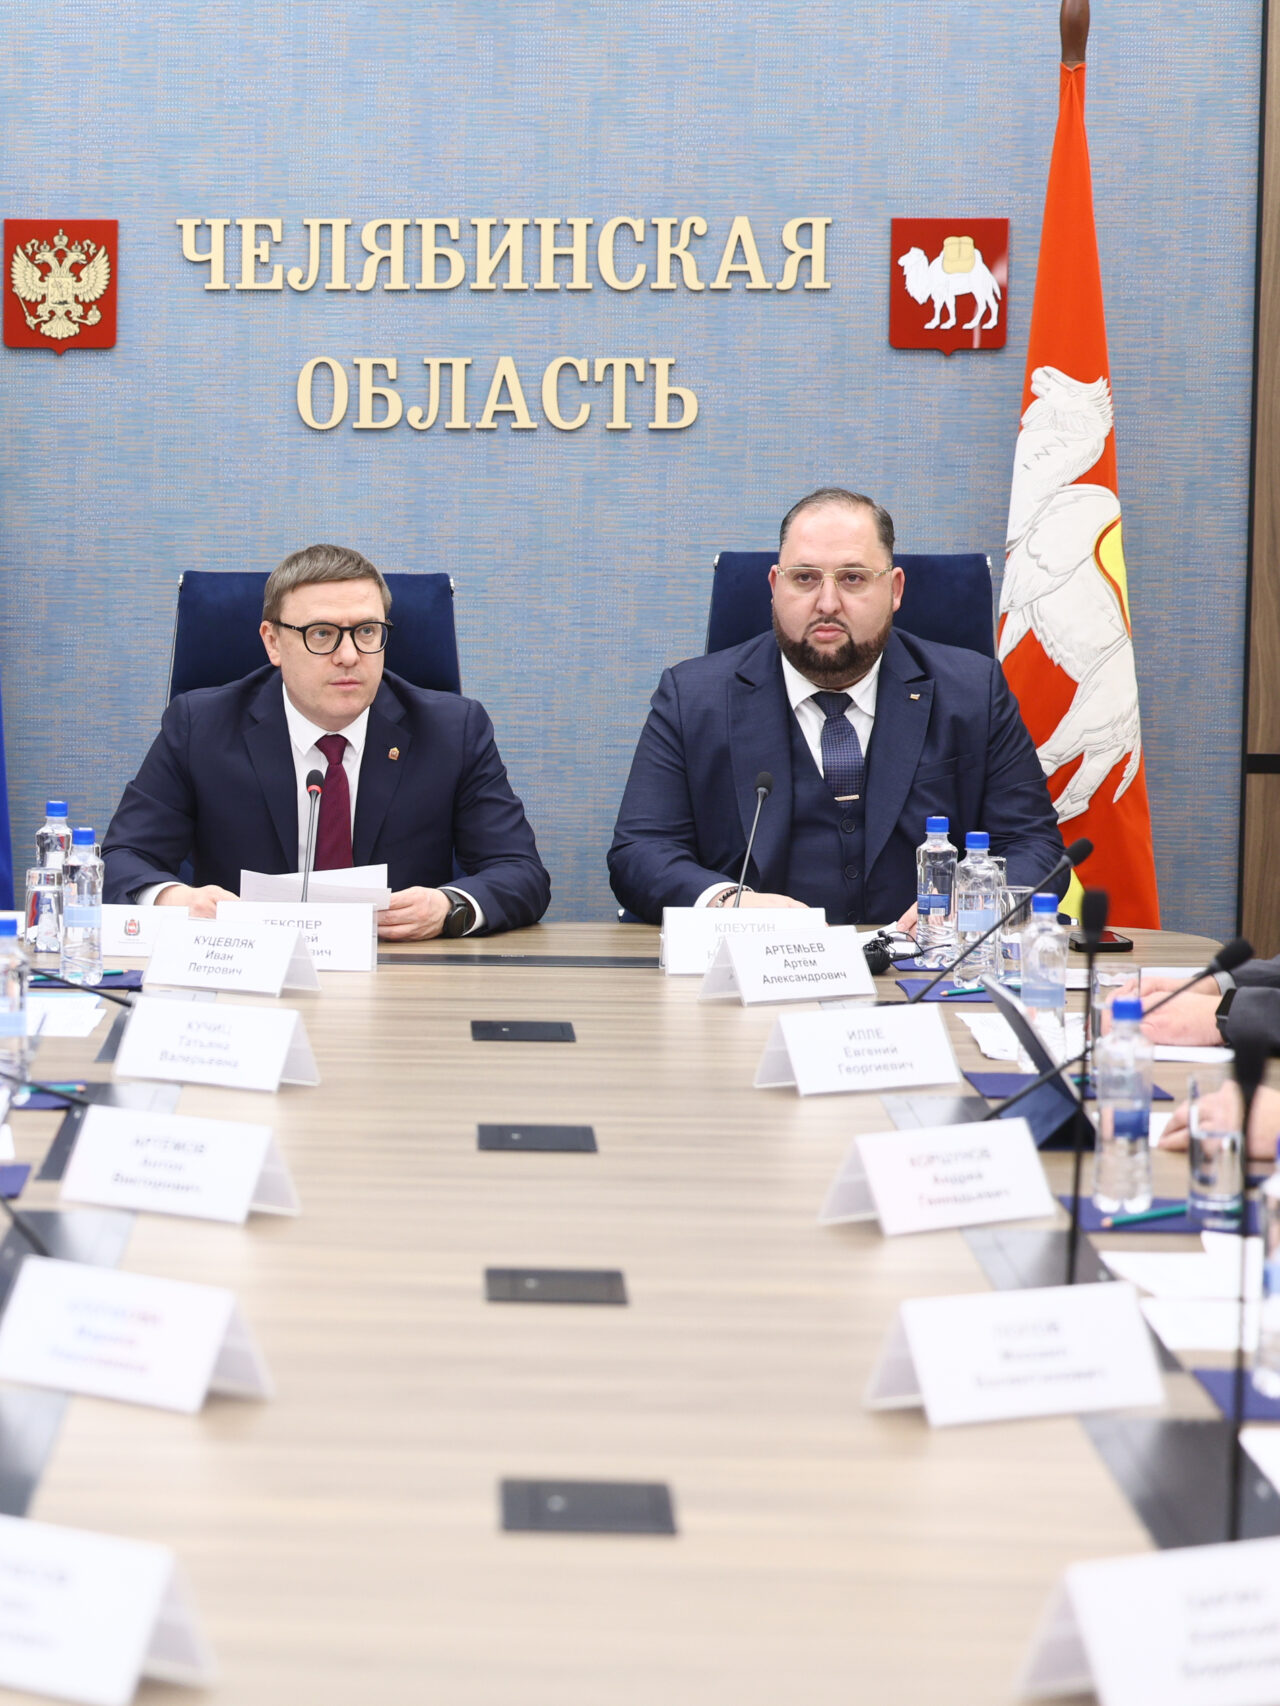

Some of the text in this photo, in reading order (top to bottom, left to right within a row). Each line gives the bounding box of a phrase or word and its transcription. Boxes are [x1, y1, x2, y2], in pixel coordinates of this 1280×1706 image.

[177, 216, 833, 291] ЧЕЛЯБИНСКАЯ
[296, 356, 700, 431] ОБЛАСТЬ
[714, 922, 776, 933] КЛЕУТИН
[193, 935, 256, 950] КУЦЕВЛЯК
[765, 942, 826, 956] АРТЕМЬЕВ
[205, 950, 233, 961] Иван
[188, 962, 242, 976] Петрович
[762, 971, 847, 985] Александрович
